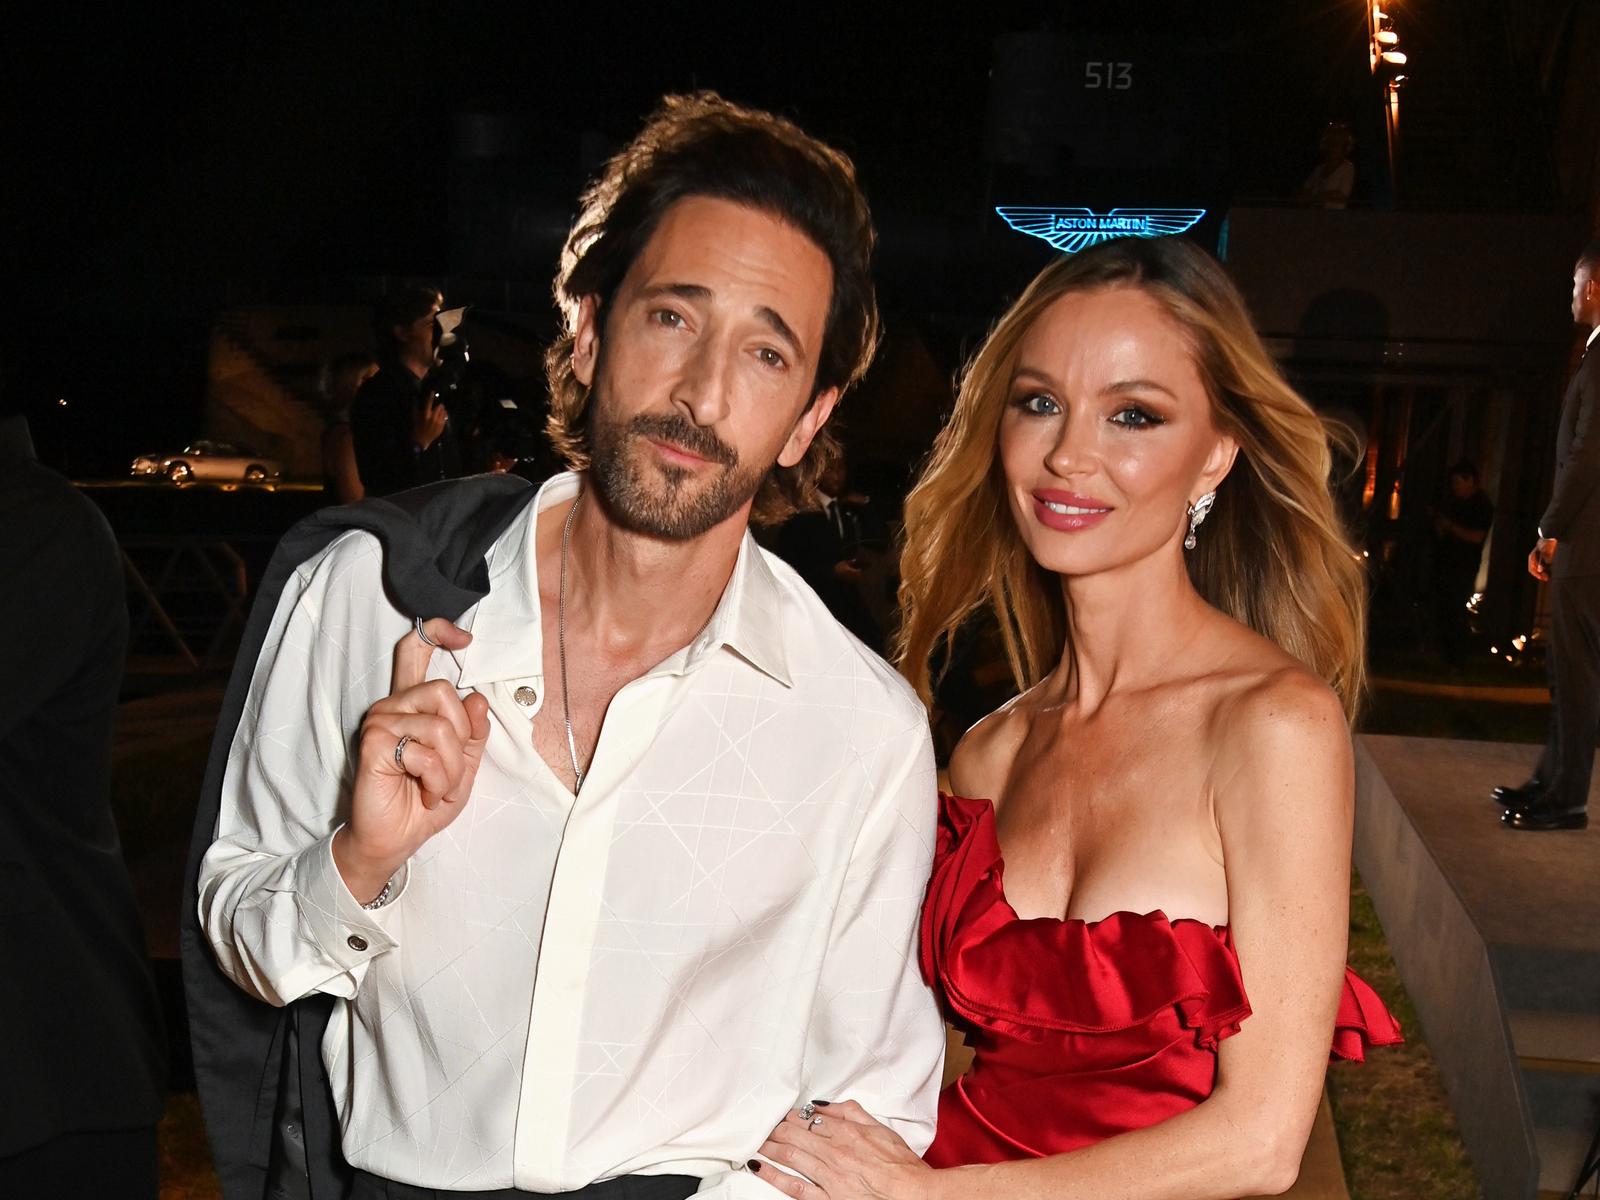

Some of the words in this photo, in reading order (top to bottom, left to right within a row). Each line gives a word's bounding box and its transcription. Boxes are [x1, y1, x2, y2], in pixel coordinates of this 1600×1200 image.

[1085, 62, 1132, 89] 513
[1056, 217, 1097, 229] ASTON
[1099, 217, 1145, 230] MARTIN
